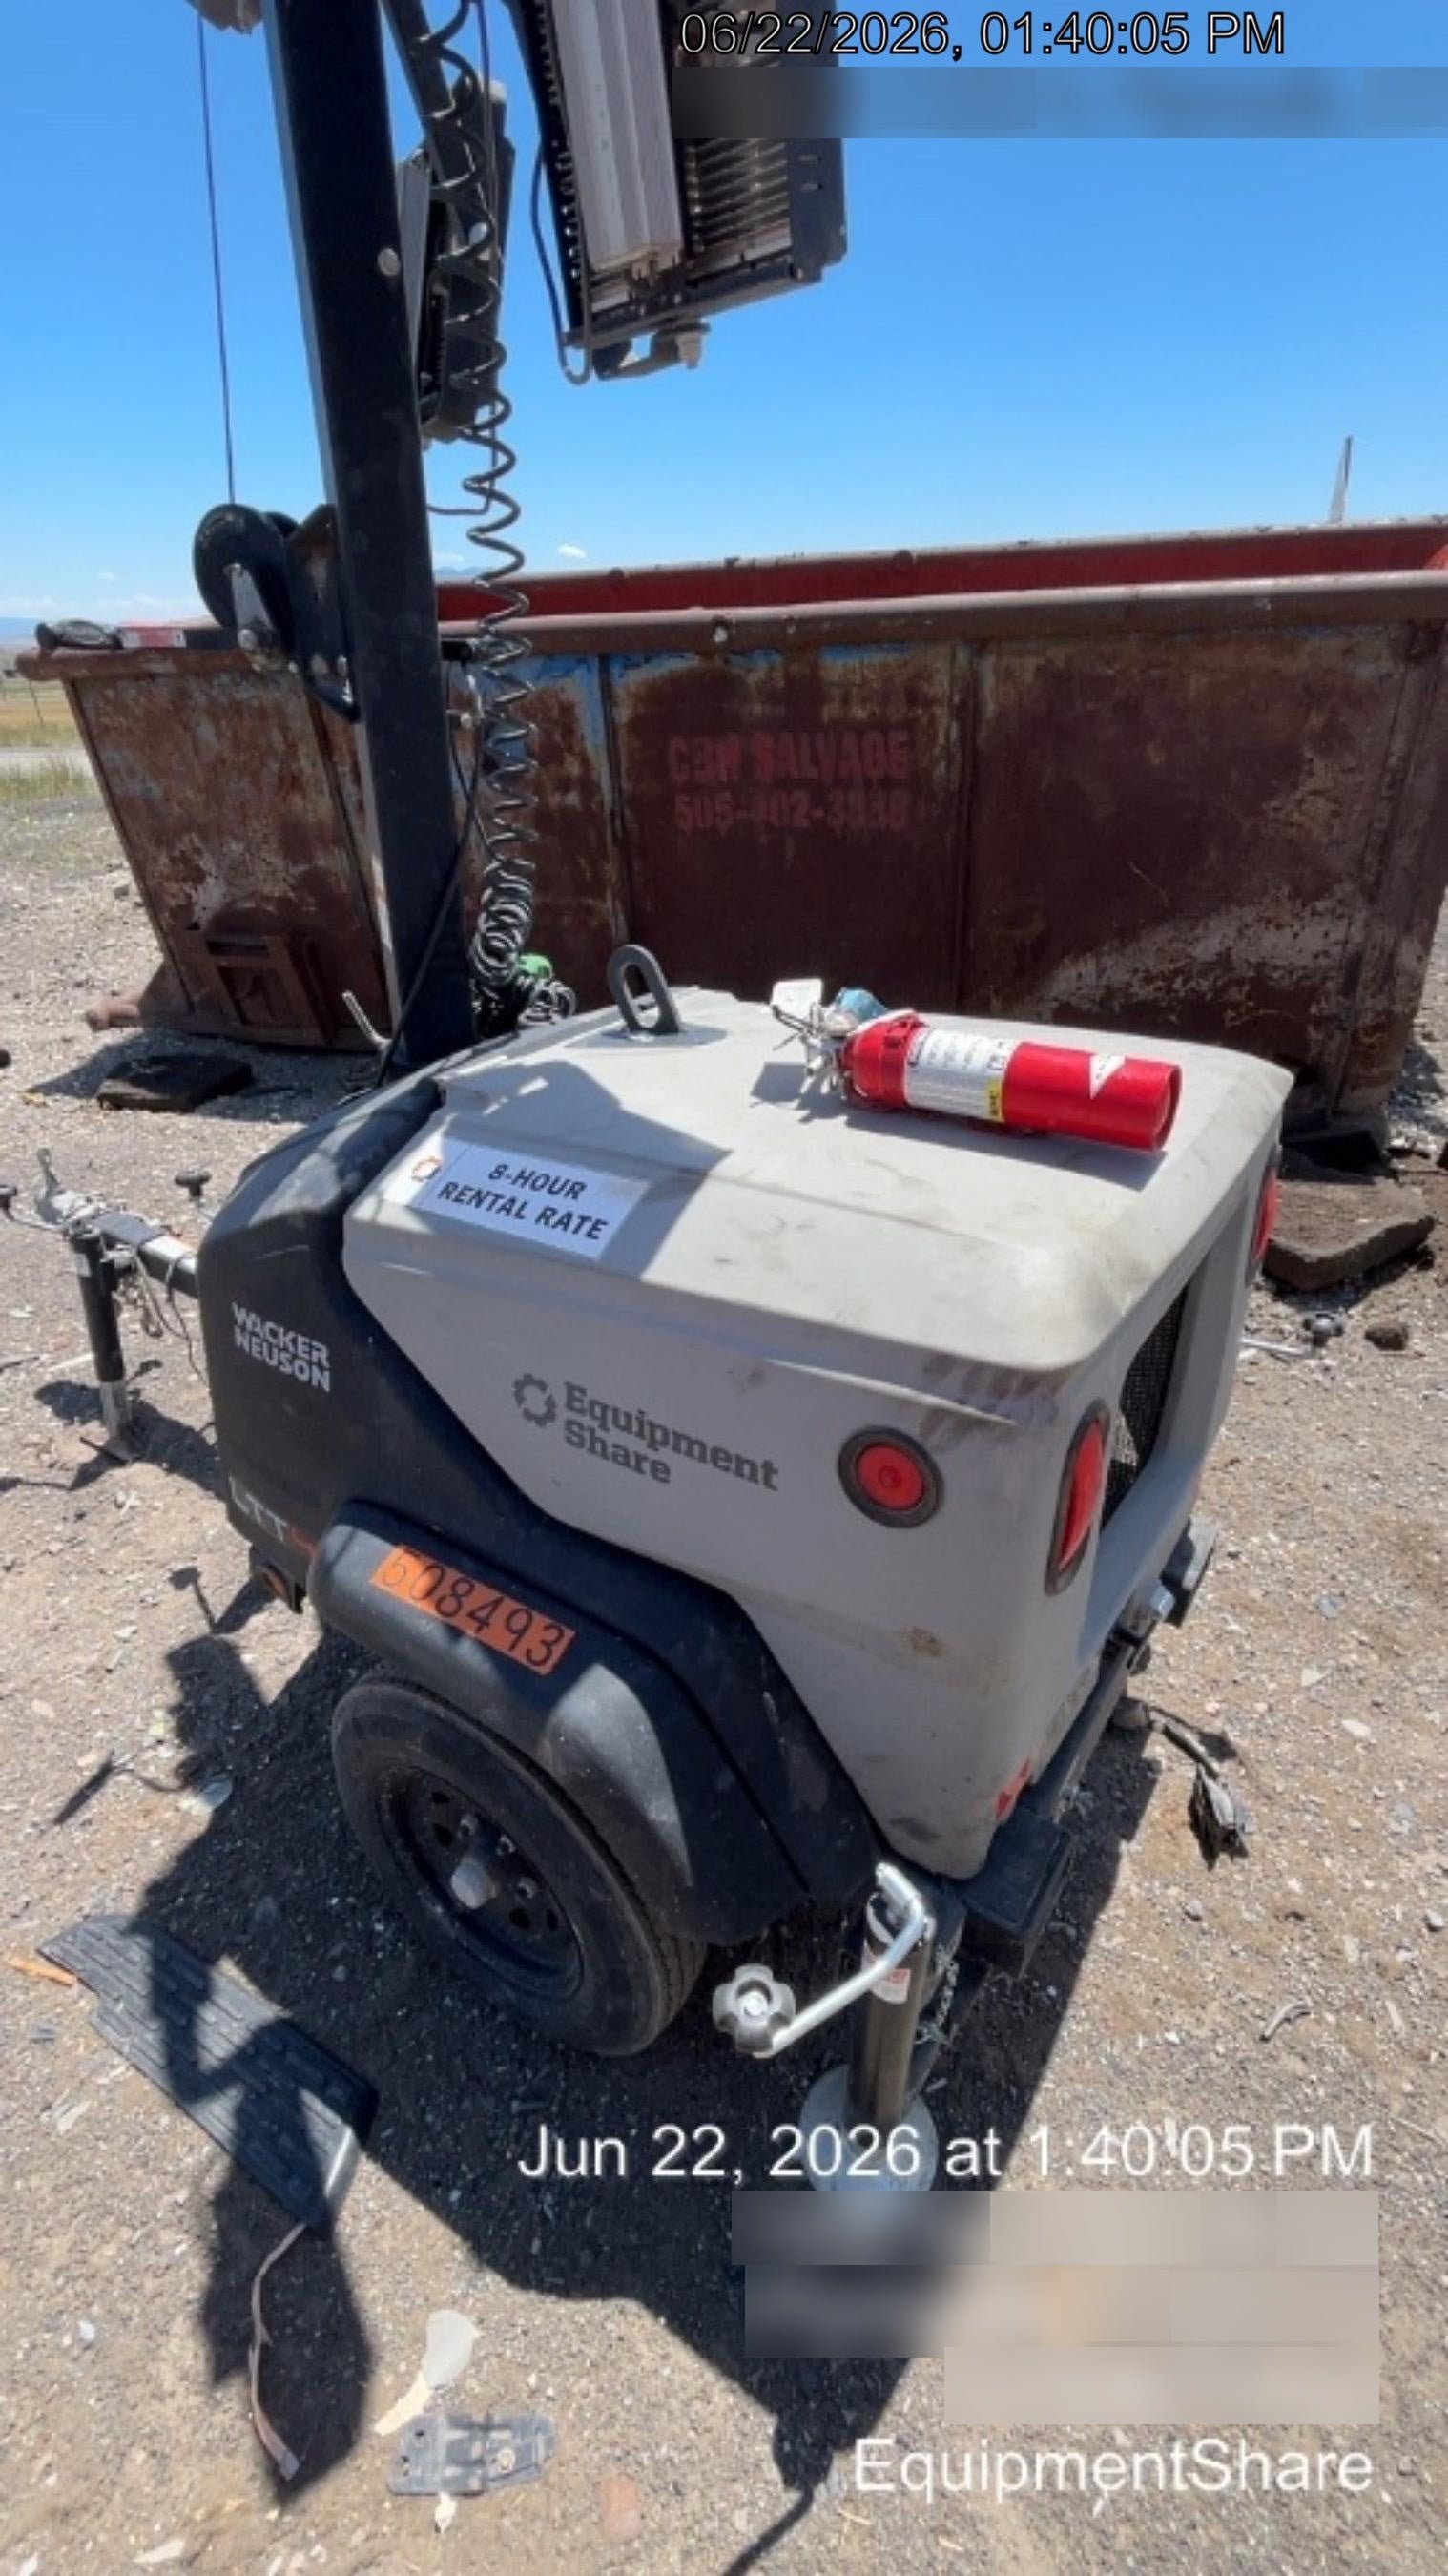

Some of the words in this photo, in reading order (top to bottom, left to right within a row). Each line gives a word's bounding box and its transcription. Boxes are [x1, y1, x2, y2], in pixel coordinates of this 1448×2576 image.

[437, 1181, 527, 1220] RENTAL
[534, 1205, 608, 1239] RATE
[487, 1163, 588, 1200] 8-HOUR
[232, 1301, 330, 1368] WACKER
[234, 1325, 330, 1392] NEUSON
[564, 1381, 779, 1492] Equipment
[564, 1418, 671, 1484] Share
